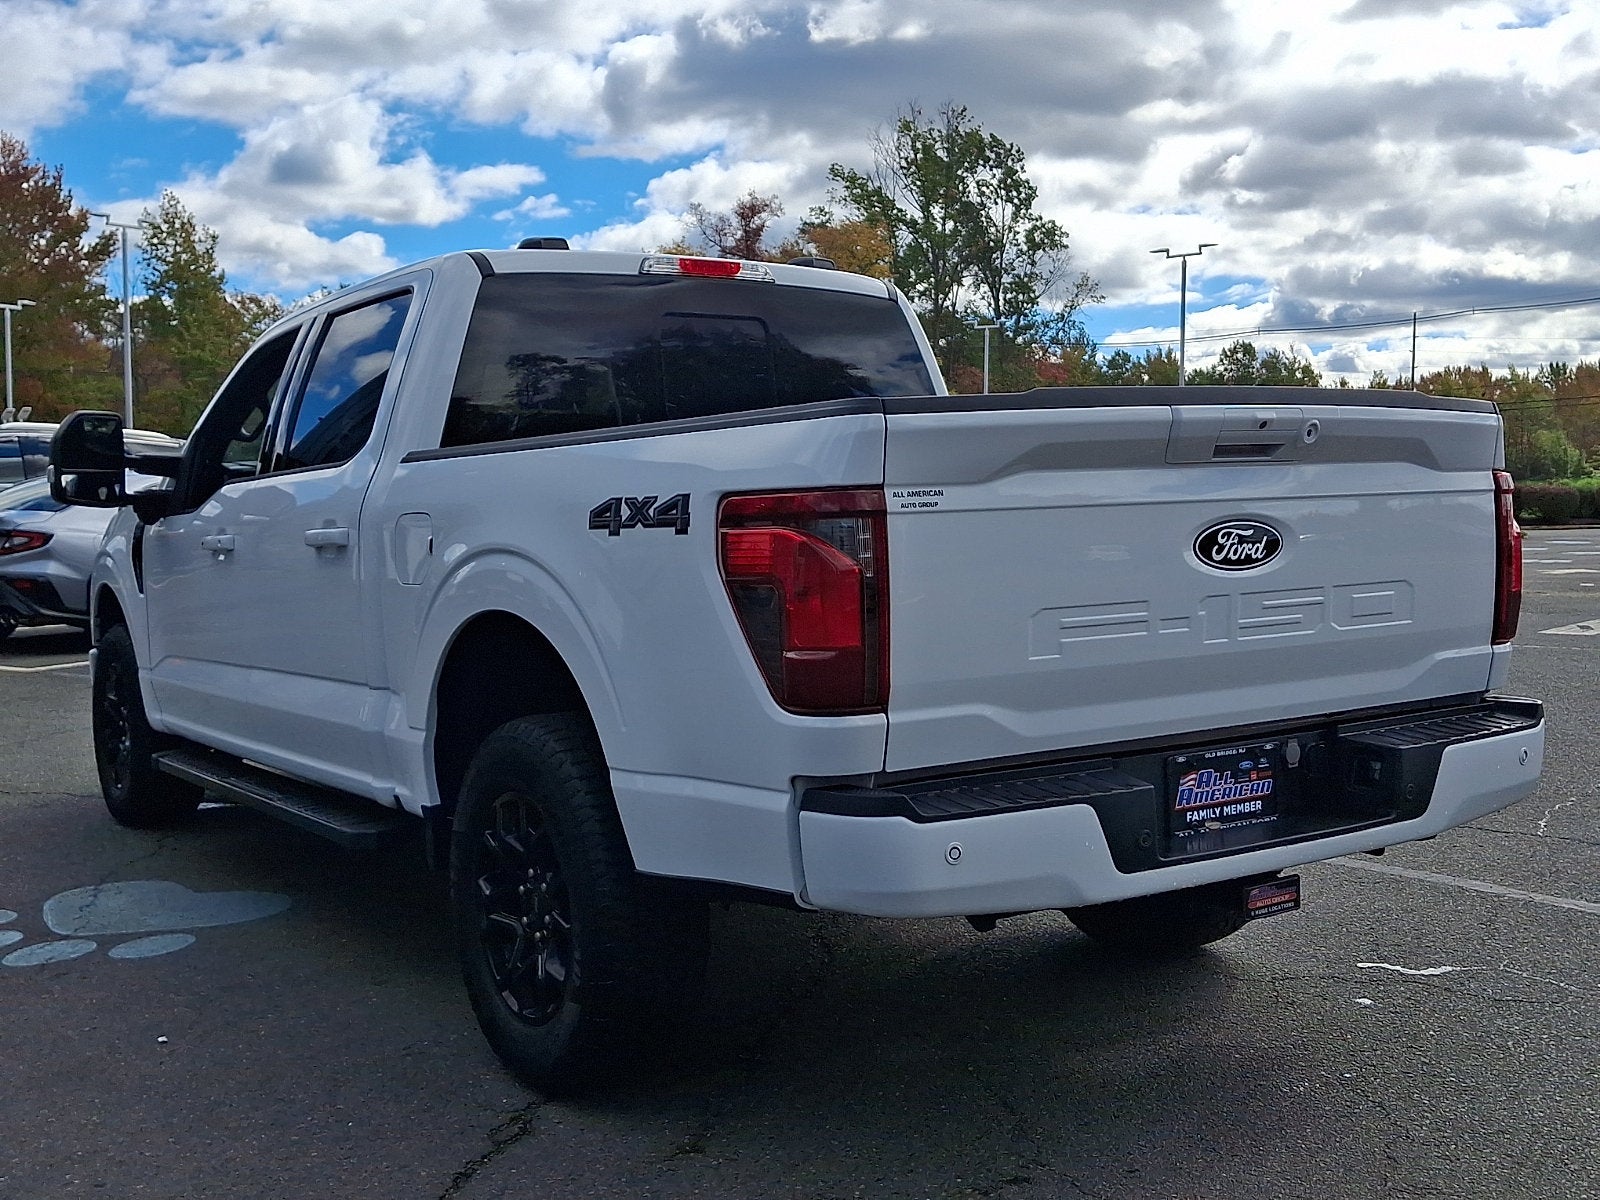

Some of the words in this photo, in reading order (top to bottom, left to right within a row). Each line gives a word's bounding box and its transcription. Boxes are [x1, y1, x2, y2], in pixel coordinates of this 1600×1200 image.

[906, 489, 944, 497] AMERICAN
[1211, 527, 1268, 562] Ford
[1028, 579, 1414, 660] F-150
[1196, 768, 1235, 790] ALL
[1176, 779, 1273, 809] AMERICAN
[1186, 807, 1221, 823] FAMILY
[1223, 800, 1262, 816] MEMBER
